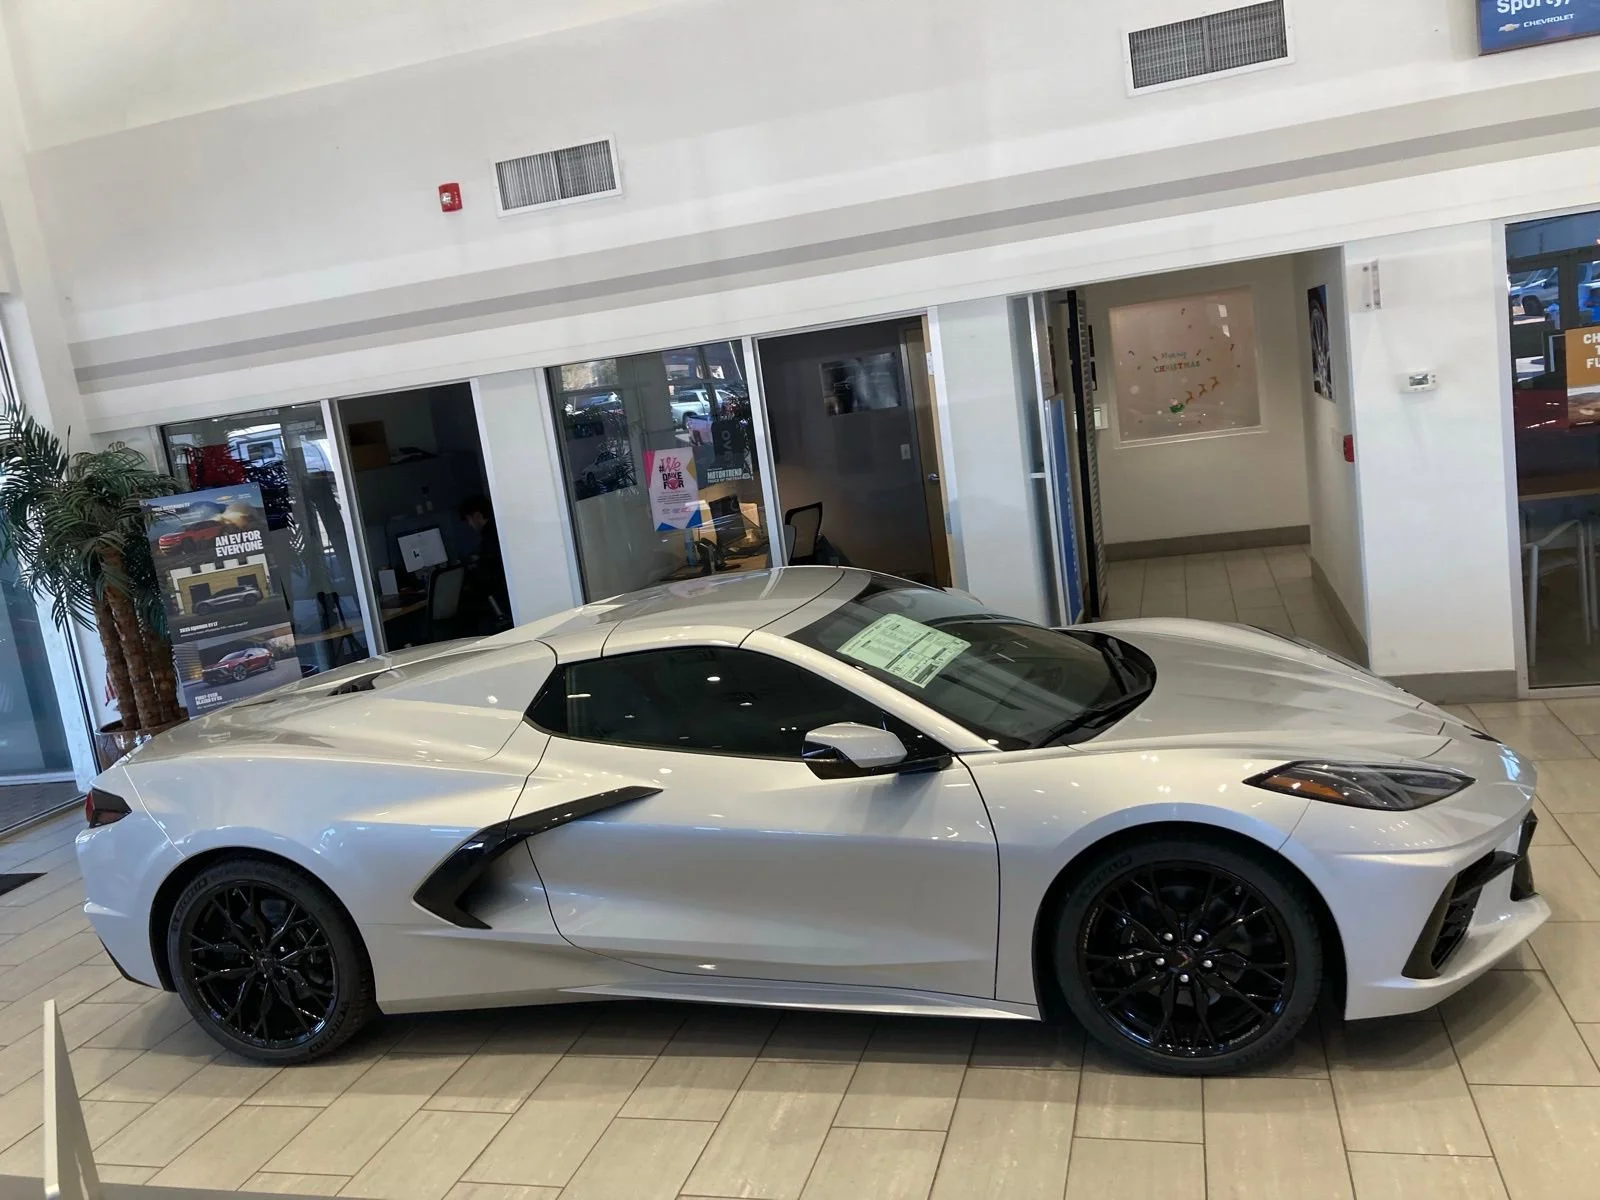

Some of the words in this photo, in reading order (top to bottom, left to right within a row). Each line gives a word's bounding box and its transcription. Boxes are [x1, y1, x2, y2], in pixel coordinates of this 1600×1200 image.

[1523, 13, 1575, 28] CHEVROLET
[707, 468, 742, 480] MOTORTREND
[215, 535, 229, 547] AN
[229, 532, 241, 545] EV
[241, 530, 262, 542] FOR
[215, 539, 264, 557] EVERYONE
